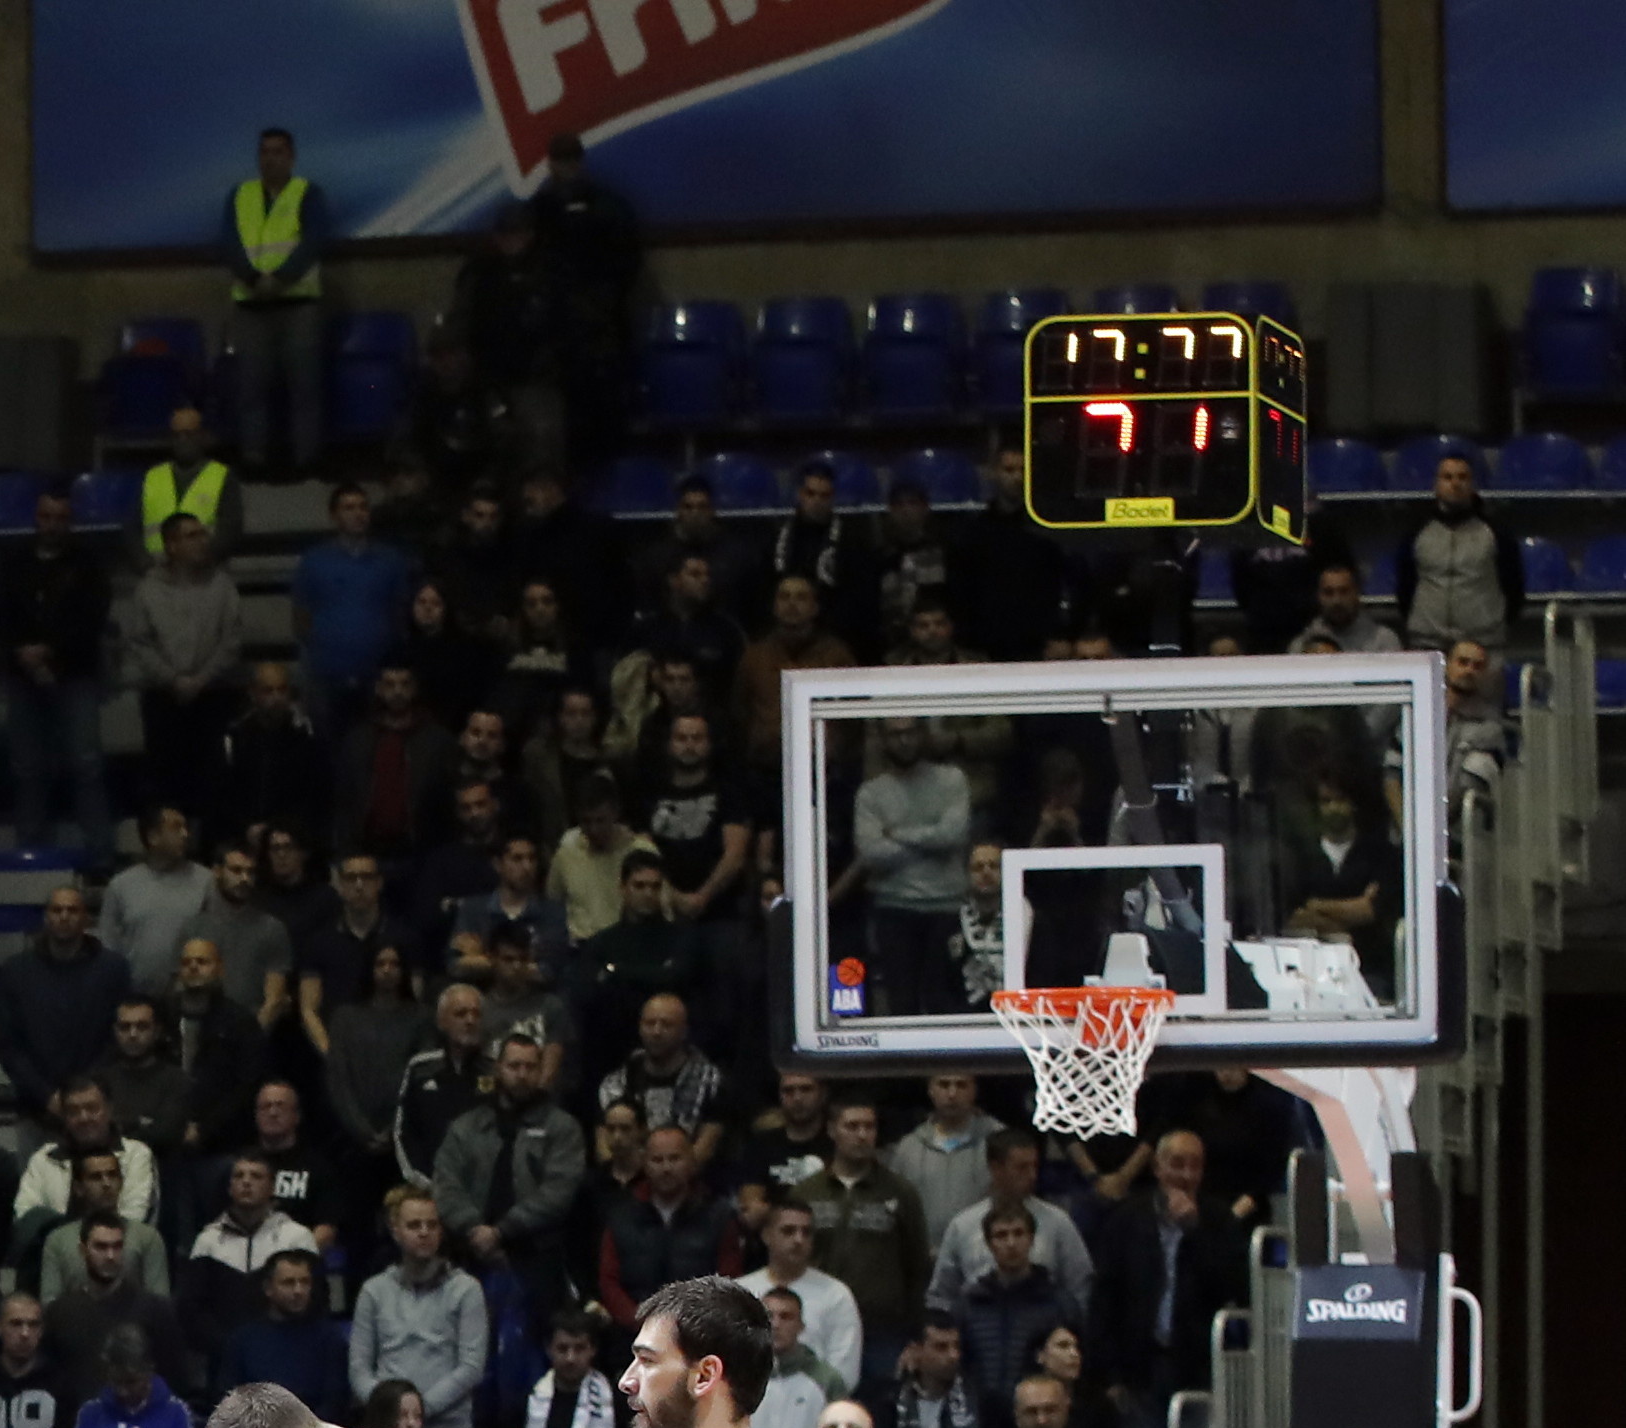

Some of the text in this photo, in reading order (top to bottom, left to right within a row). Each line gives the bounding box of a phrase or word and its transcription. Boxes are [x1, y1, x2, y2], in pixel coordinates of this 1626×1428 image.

[832, 988, 863, 1011] ABA
[817, 1033, 879, 1049] SPALDING
[1306, 1298, 1408, 1324] SPALDING
